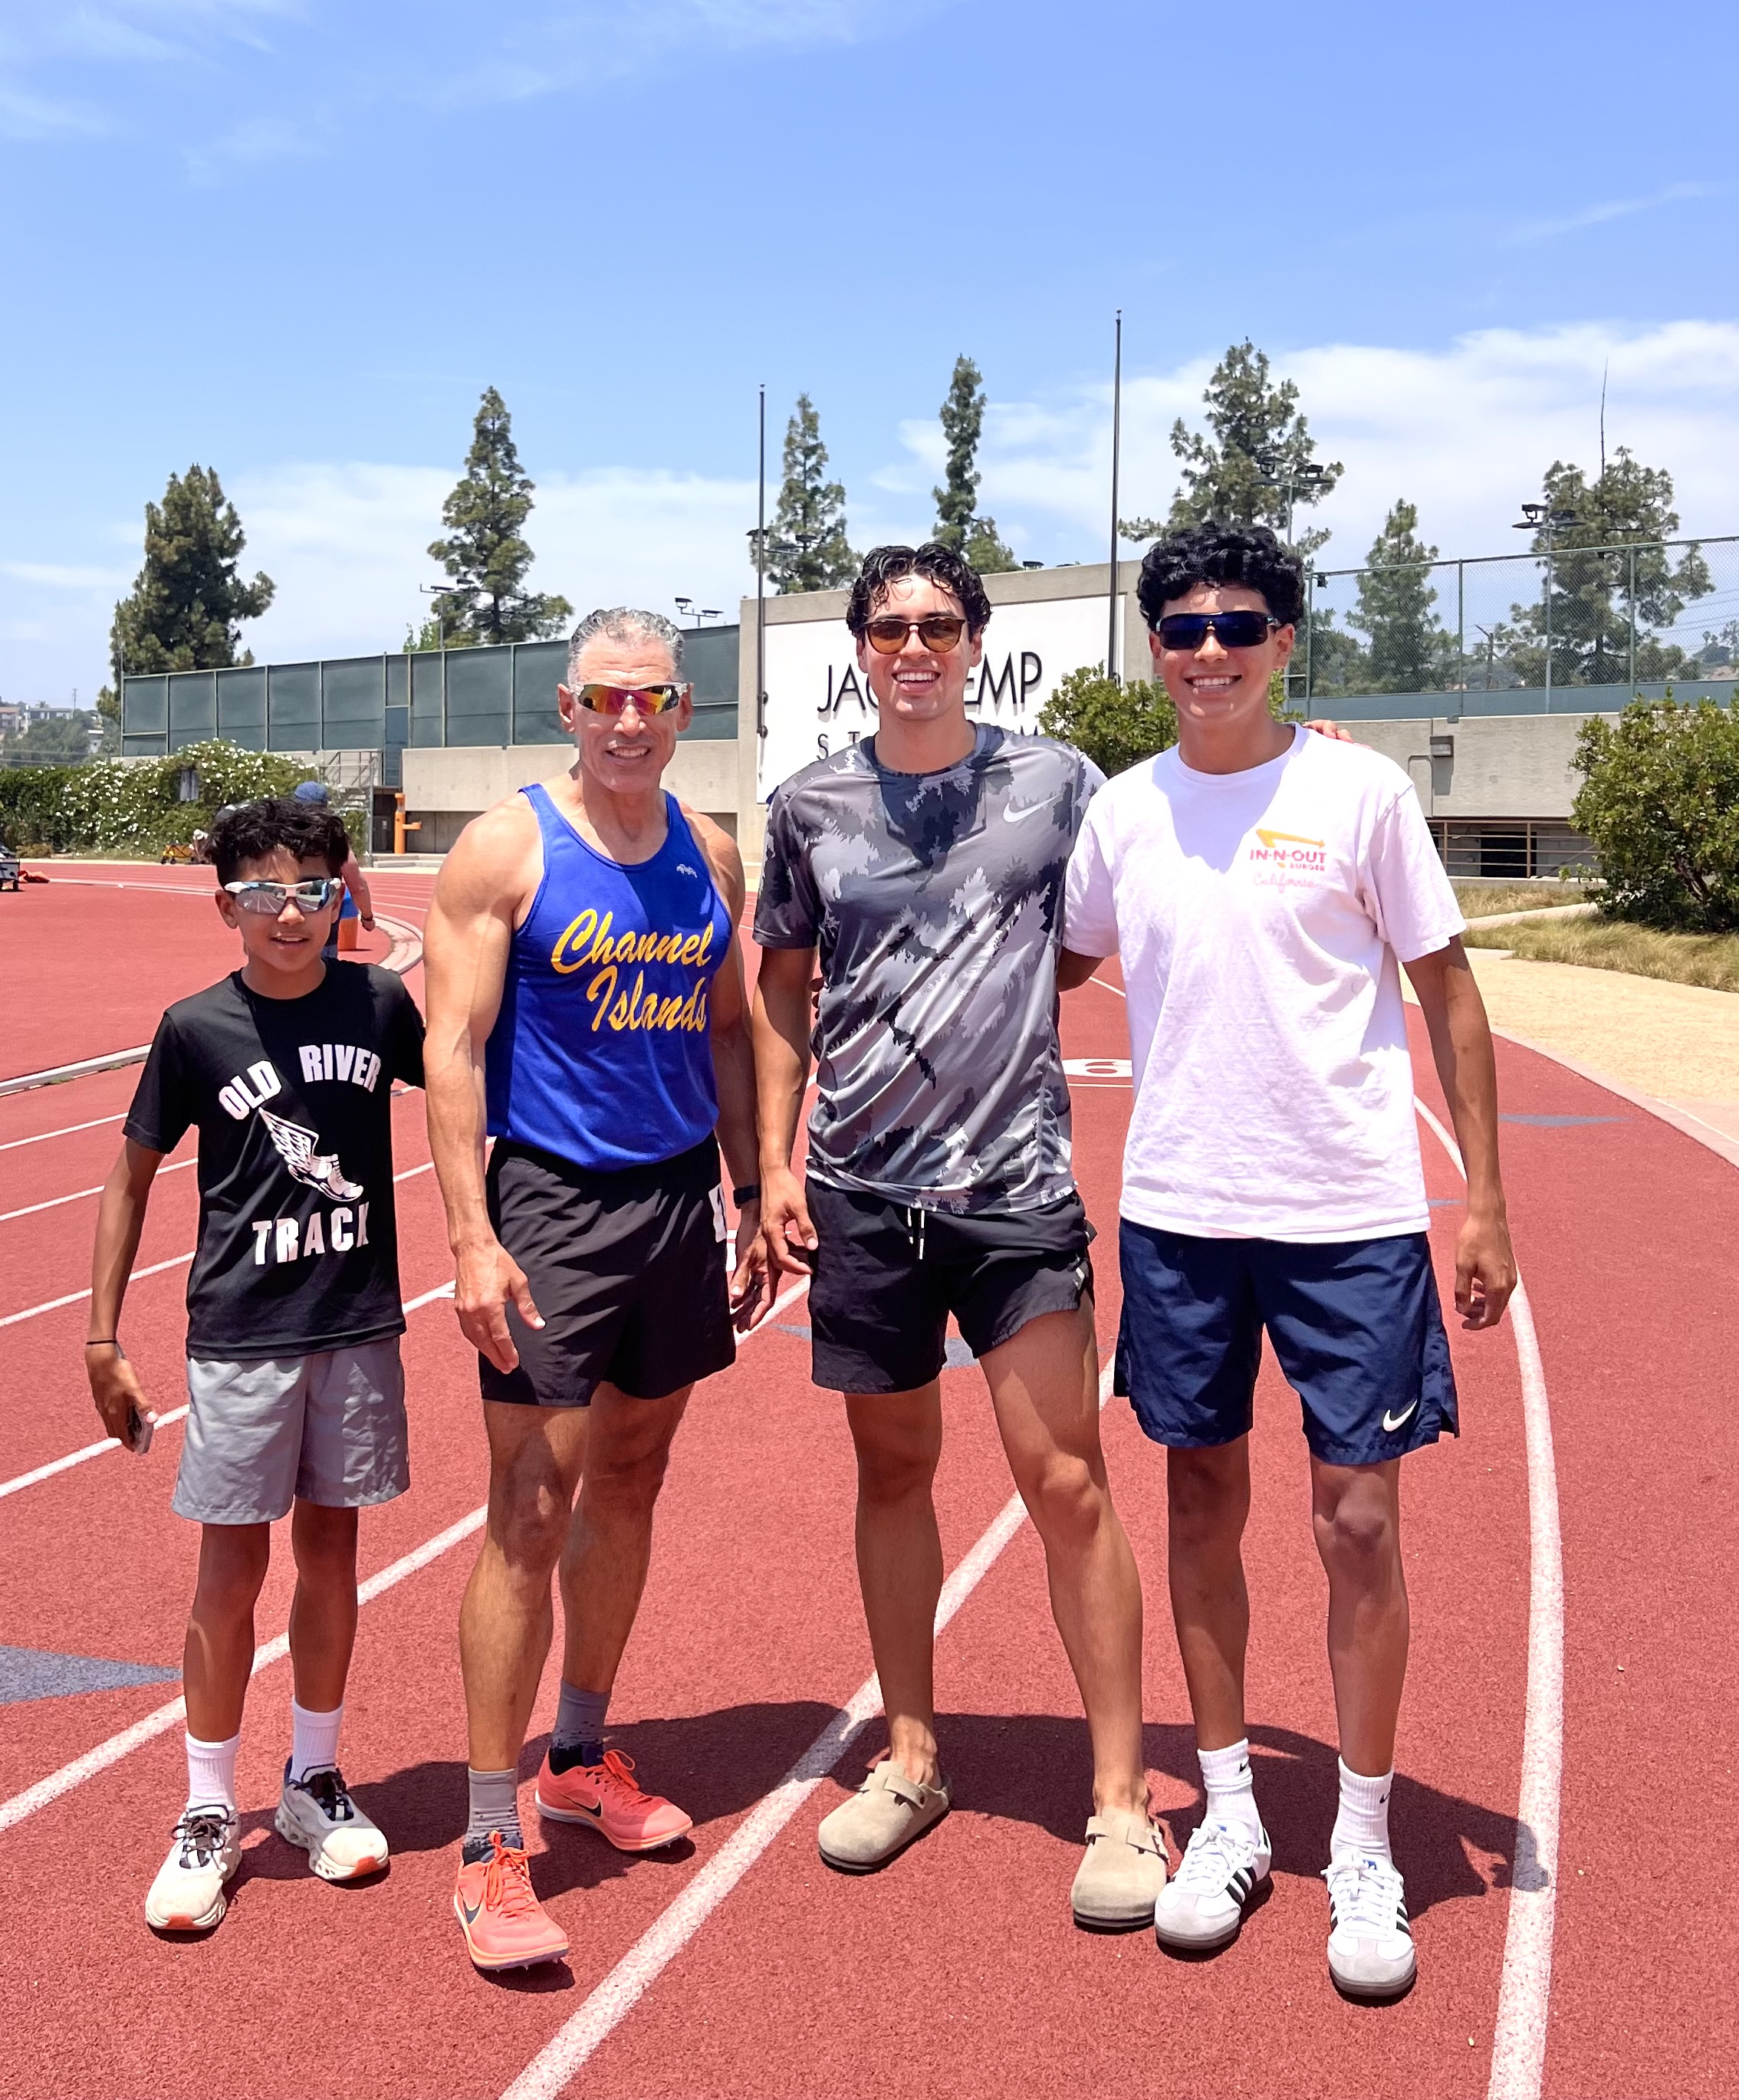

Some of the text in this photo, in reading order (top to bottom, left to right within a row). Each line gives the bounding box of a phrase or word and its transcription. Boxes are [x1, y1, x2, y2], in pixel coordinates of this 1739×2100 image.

[817, 662, 879, 713] JA
[1250, 850, 1326, 863] IN-N-OUT
[1254, 872, 1317, 893] California
[551, 908, 714, 974] Channel
[586, 965, 707, 1033] Islands
[219, 1043, 382, 1120] OLD RIVER
[252, 1201, 370, 1265] TRACK
